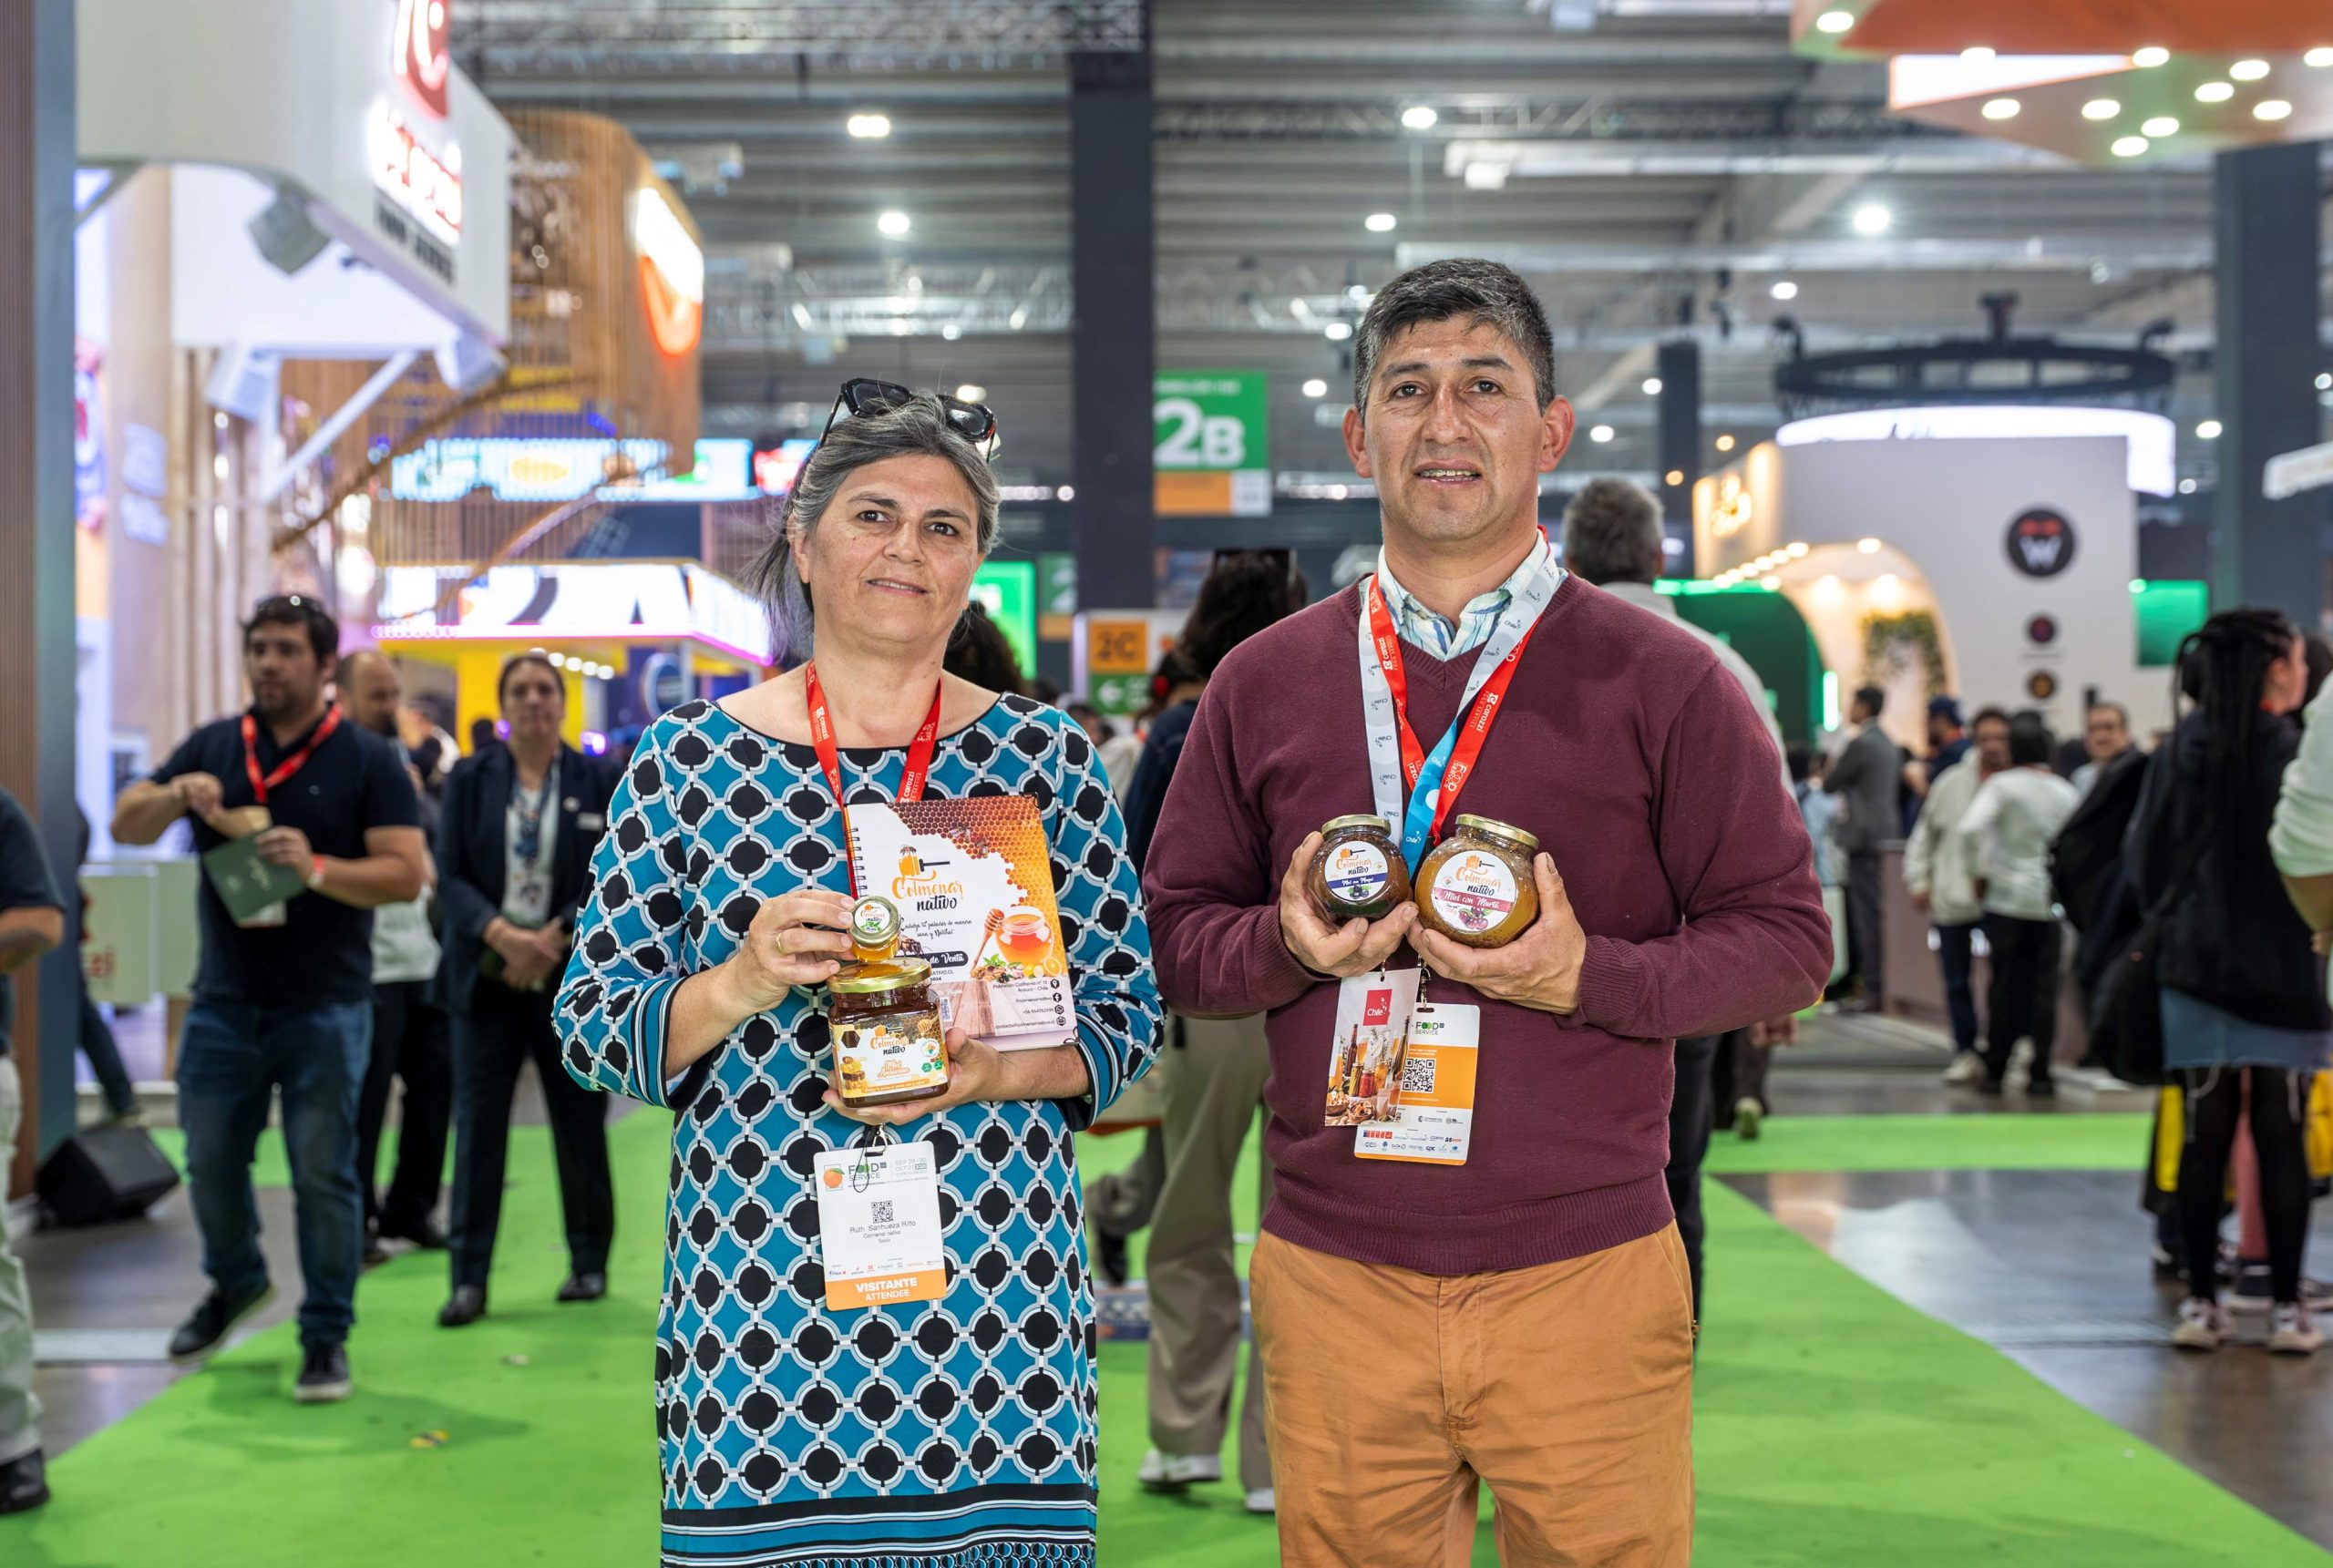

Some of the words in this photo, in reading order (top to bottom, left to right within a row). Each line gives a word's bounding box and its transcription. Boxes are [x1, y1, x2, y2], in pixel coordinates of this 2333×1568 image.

[1152, 397, 1246, 468] 2B
[1526, 590, 1537, 600] Chile
[1505, 620, 1518, 630] Chile
[1097, 630, 1138, 662] 2C
[1378, 638, 1390, 660] carozzi
[1476, 705, 1492, 733] carozzi
[903, 771, 915, 797] carozzi
[1448, 765, 1467, 792] FOOD
[1336, 859, 1372, 870] Colmenar
[1348, 866, 1369, 876] nativo
[1455, 866, 1503, 890] Colmenar
[892, 876, 964, 900] Colmenar
[1467, 885, 1495, 897] nativo
[917, 895, 958, 912] nativo
[1443, 890, 1461, 901] Miel
[1462, 897, 1474, 905] con
[1476, 897, 1500, 909] Murta
[930, 956, 940, 964] de
[941, 952, 964, 964] Venta
[1367, 1008, 1383, 1017] Chile
[1415, 1021, 1439, 1030] FOOD
[870, 1038, 910, 1050] Colmenar
[883, 1046, 906, 1056] nativo
[848, 1163, 880, 1175] FOOD
[849, 1172, 881, 1182] SERVICE
[868, 1223, 900, 1232] Sanhueza
[855, 1277, 918, 1293] VISITANTE
[866, 1289, 910, 1301] ATTENDEE
